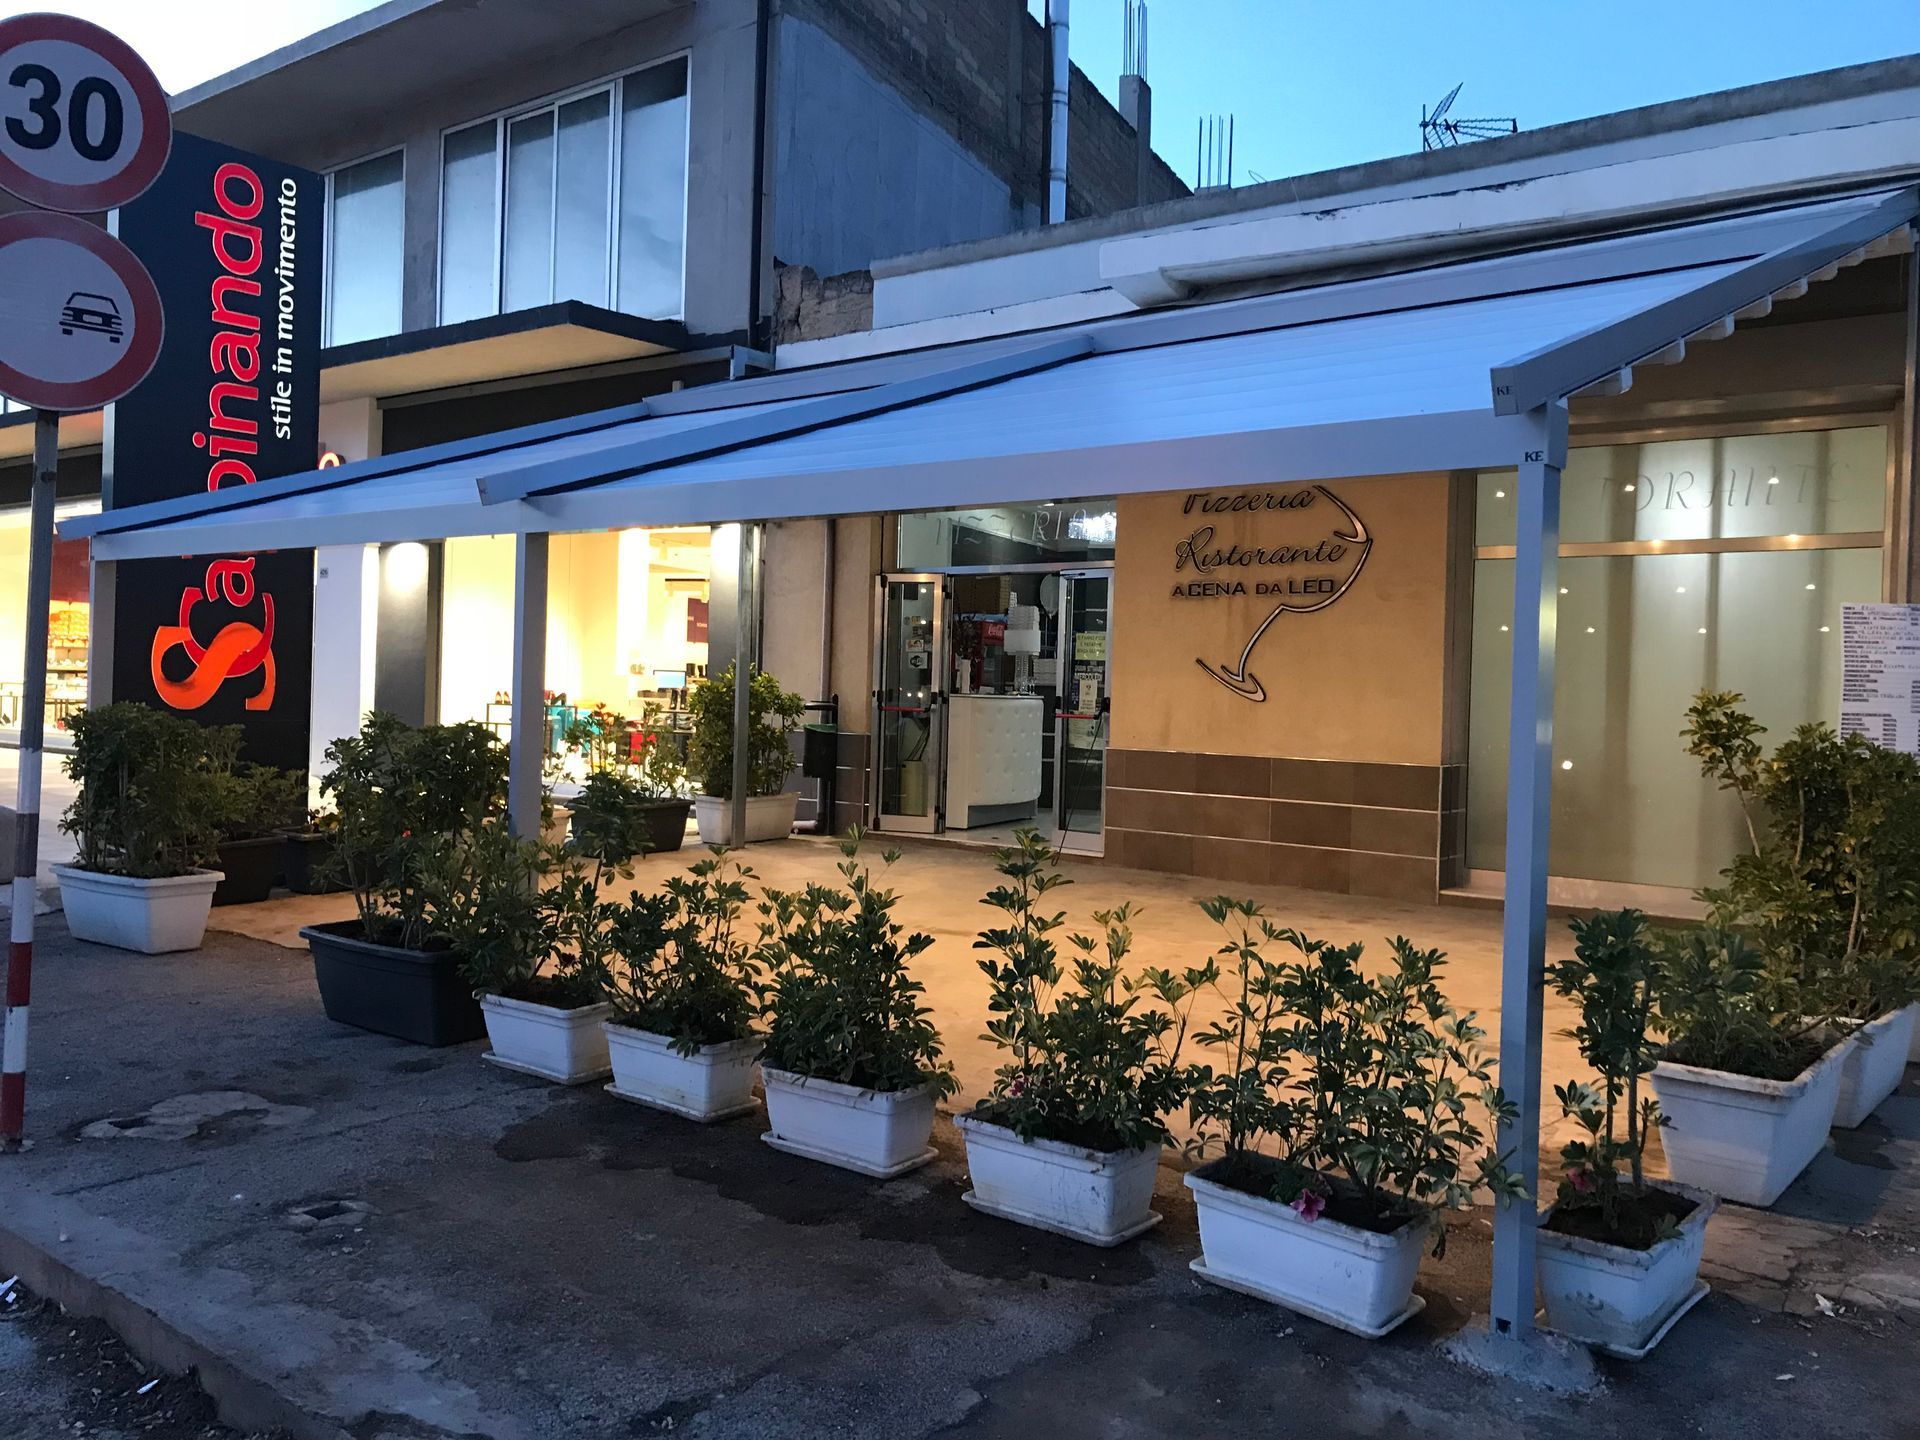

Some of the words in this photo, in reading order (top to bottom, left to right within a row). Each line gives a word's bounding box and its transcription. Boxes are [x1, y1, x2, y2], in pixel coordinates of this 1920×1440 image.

[5, 63, 124, 162] 30
[274, 178, 298, 341] movimento
[272, 345, 295, 371] in
[273, 373, 293, 440] stile
[1496, 385, 1514, 396] KE
[1524, 450, 1545, 462] KE
[1175, 525, 1348, 574] Ristorante
[1256, 583, 1282, 595] DA
[1288, 579, 1334, 595] LEO
